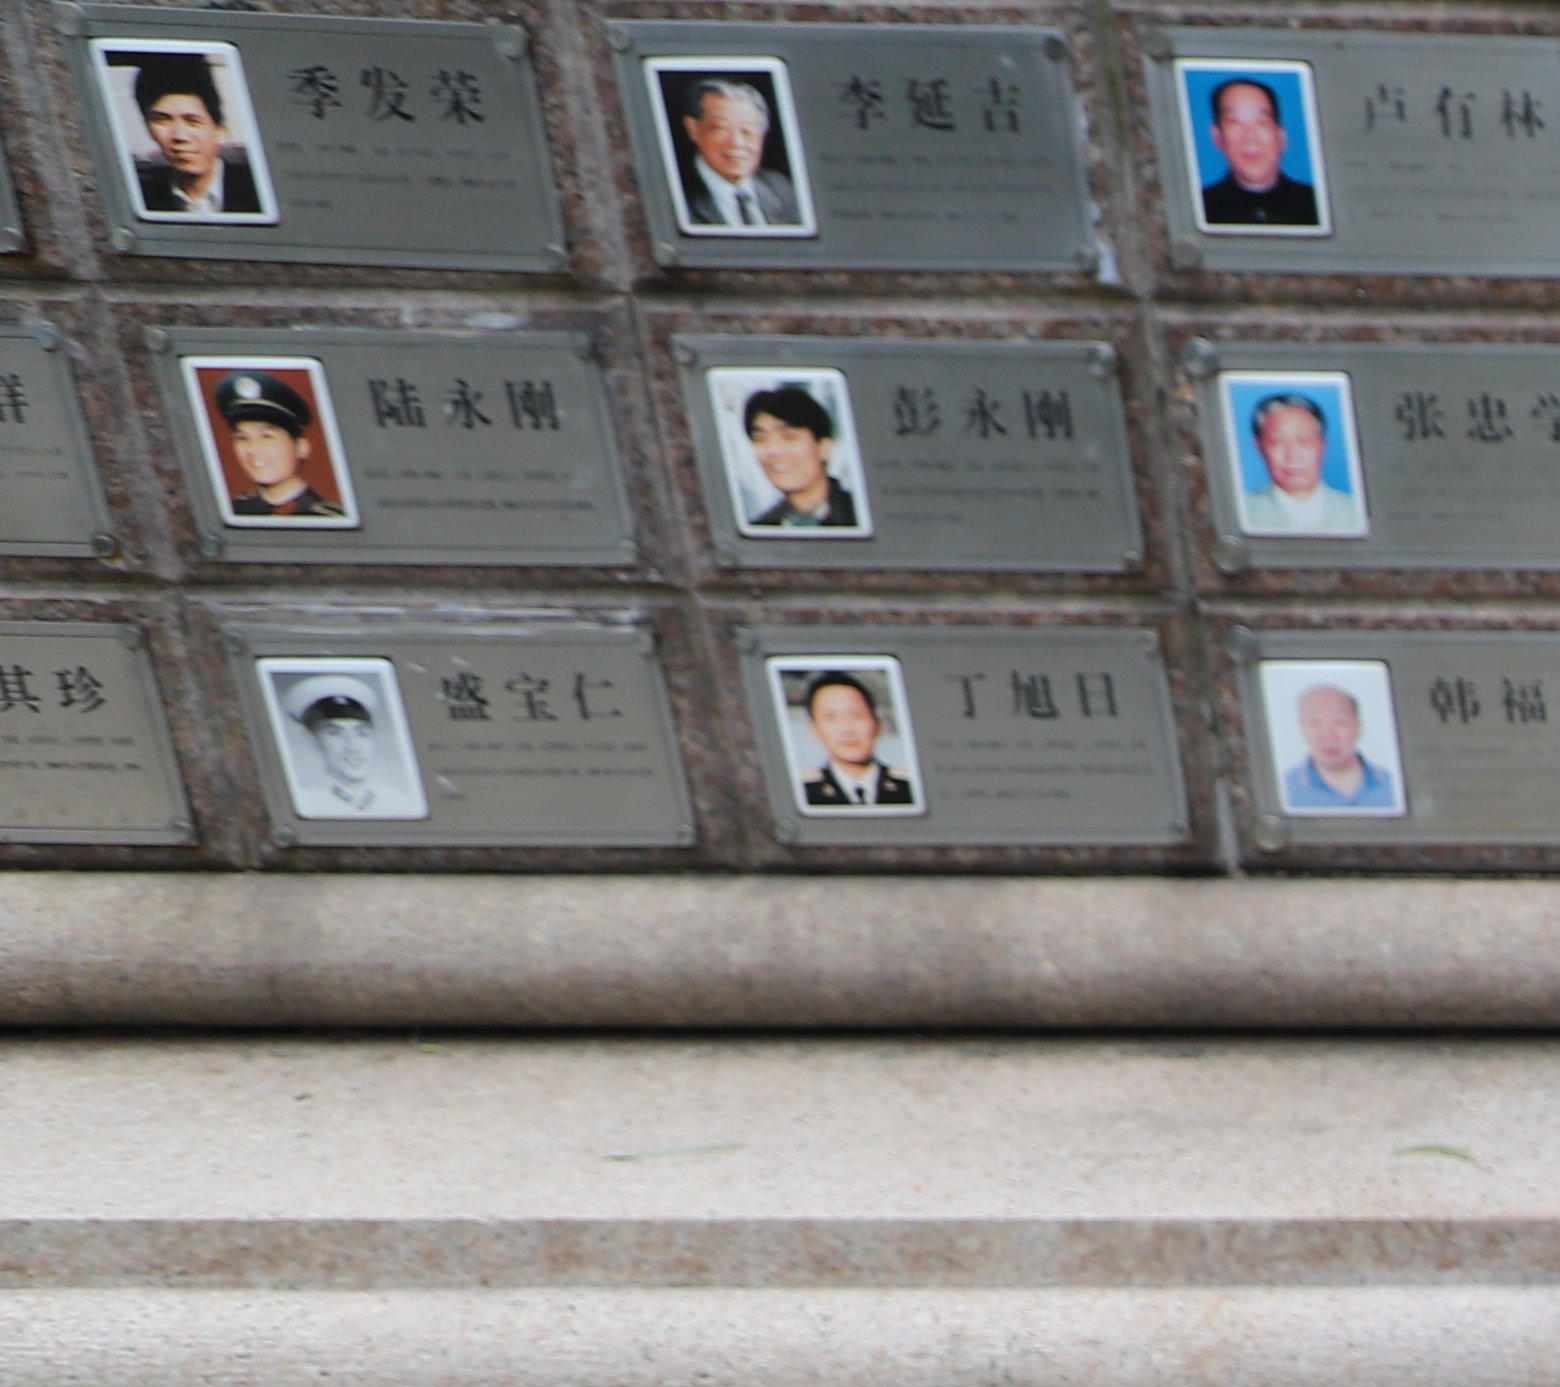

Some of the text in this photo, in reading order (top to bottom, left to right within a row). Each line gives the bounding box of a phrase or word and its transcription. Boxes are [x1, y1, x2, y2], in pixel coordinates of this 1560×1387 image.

[293, 64, 486, 126] 季发荣
[839, 74, 1021, 134] 李延吉
[366, 376, 561, 432] 陆永刚
[892, 385, 1076, 442] 彭永刚
[439, 670, 623, 723] 盛宝仁
[940, 669, 1119, 722] 丁旭日
